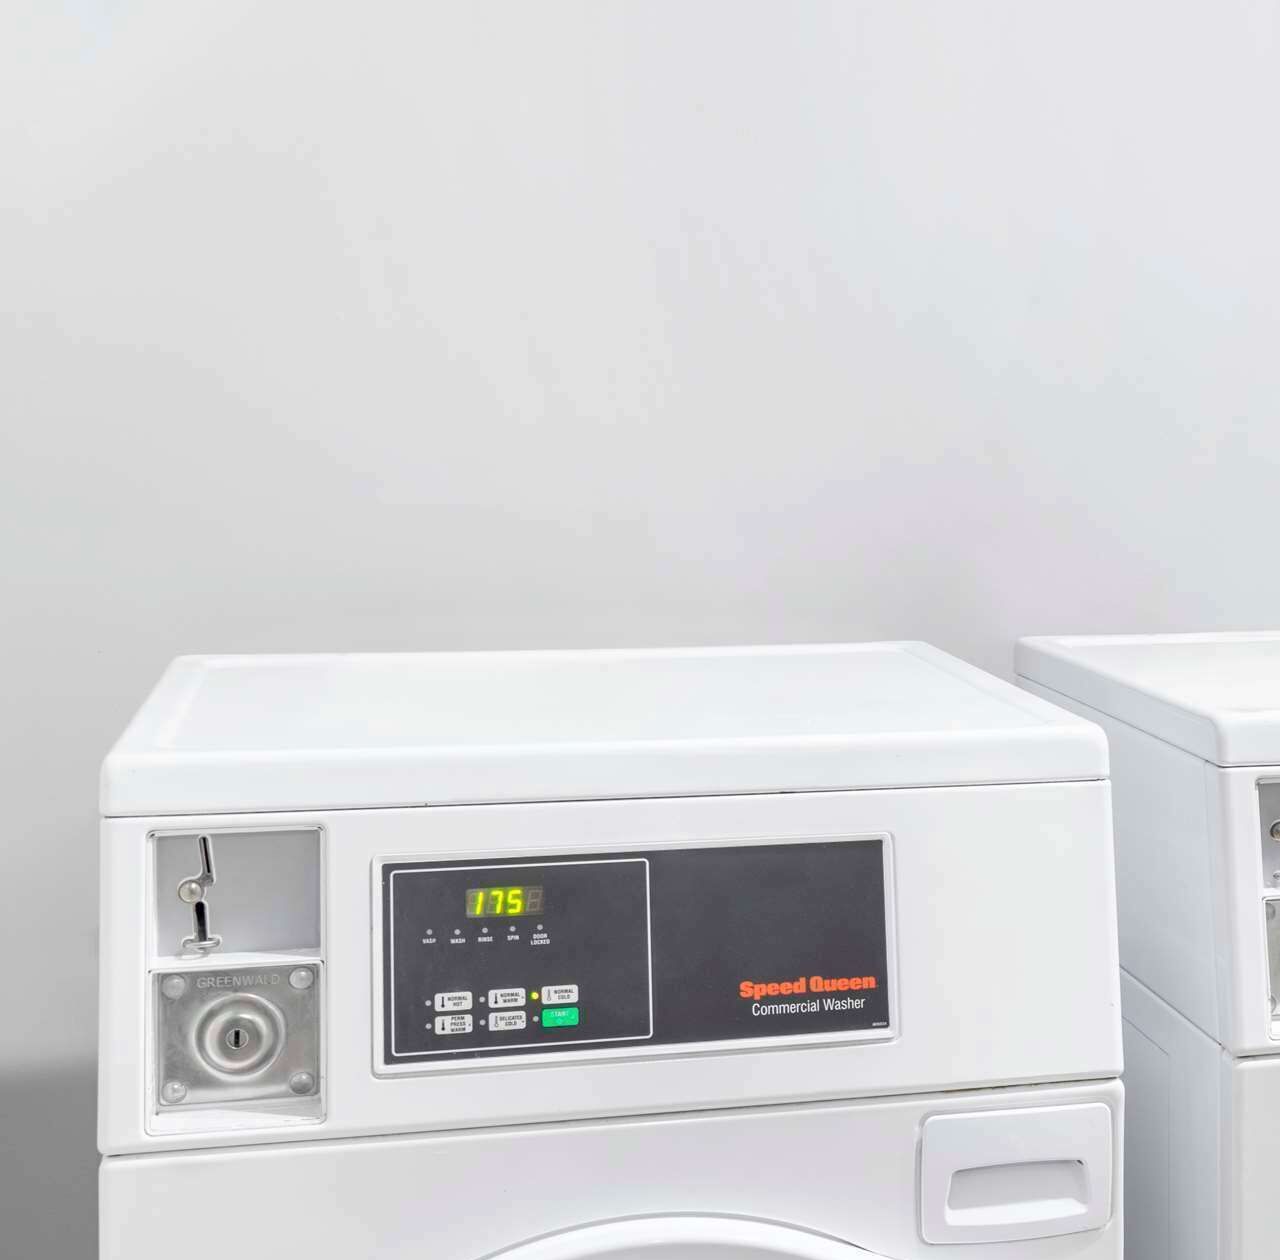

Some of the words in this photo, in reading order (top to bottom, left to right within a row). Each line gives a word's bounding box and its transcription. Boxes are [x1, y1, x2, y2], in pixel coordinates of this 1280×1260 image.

[475, 889, 523, 915] 175
[196, 974, 280, 989] GREENWALD
[739, 977, 807, 1000] Speed
[808, 975, 877, 993] Queen
[752, 999, 820, 1016] Commercial
[823, 997, 866, 1011] Washer
